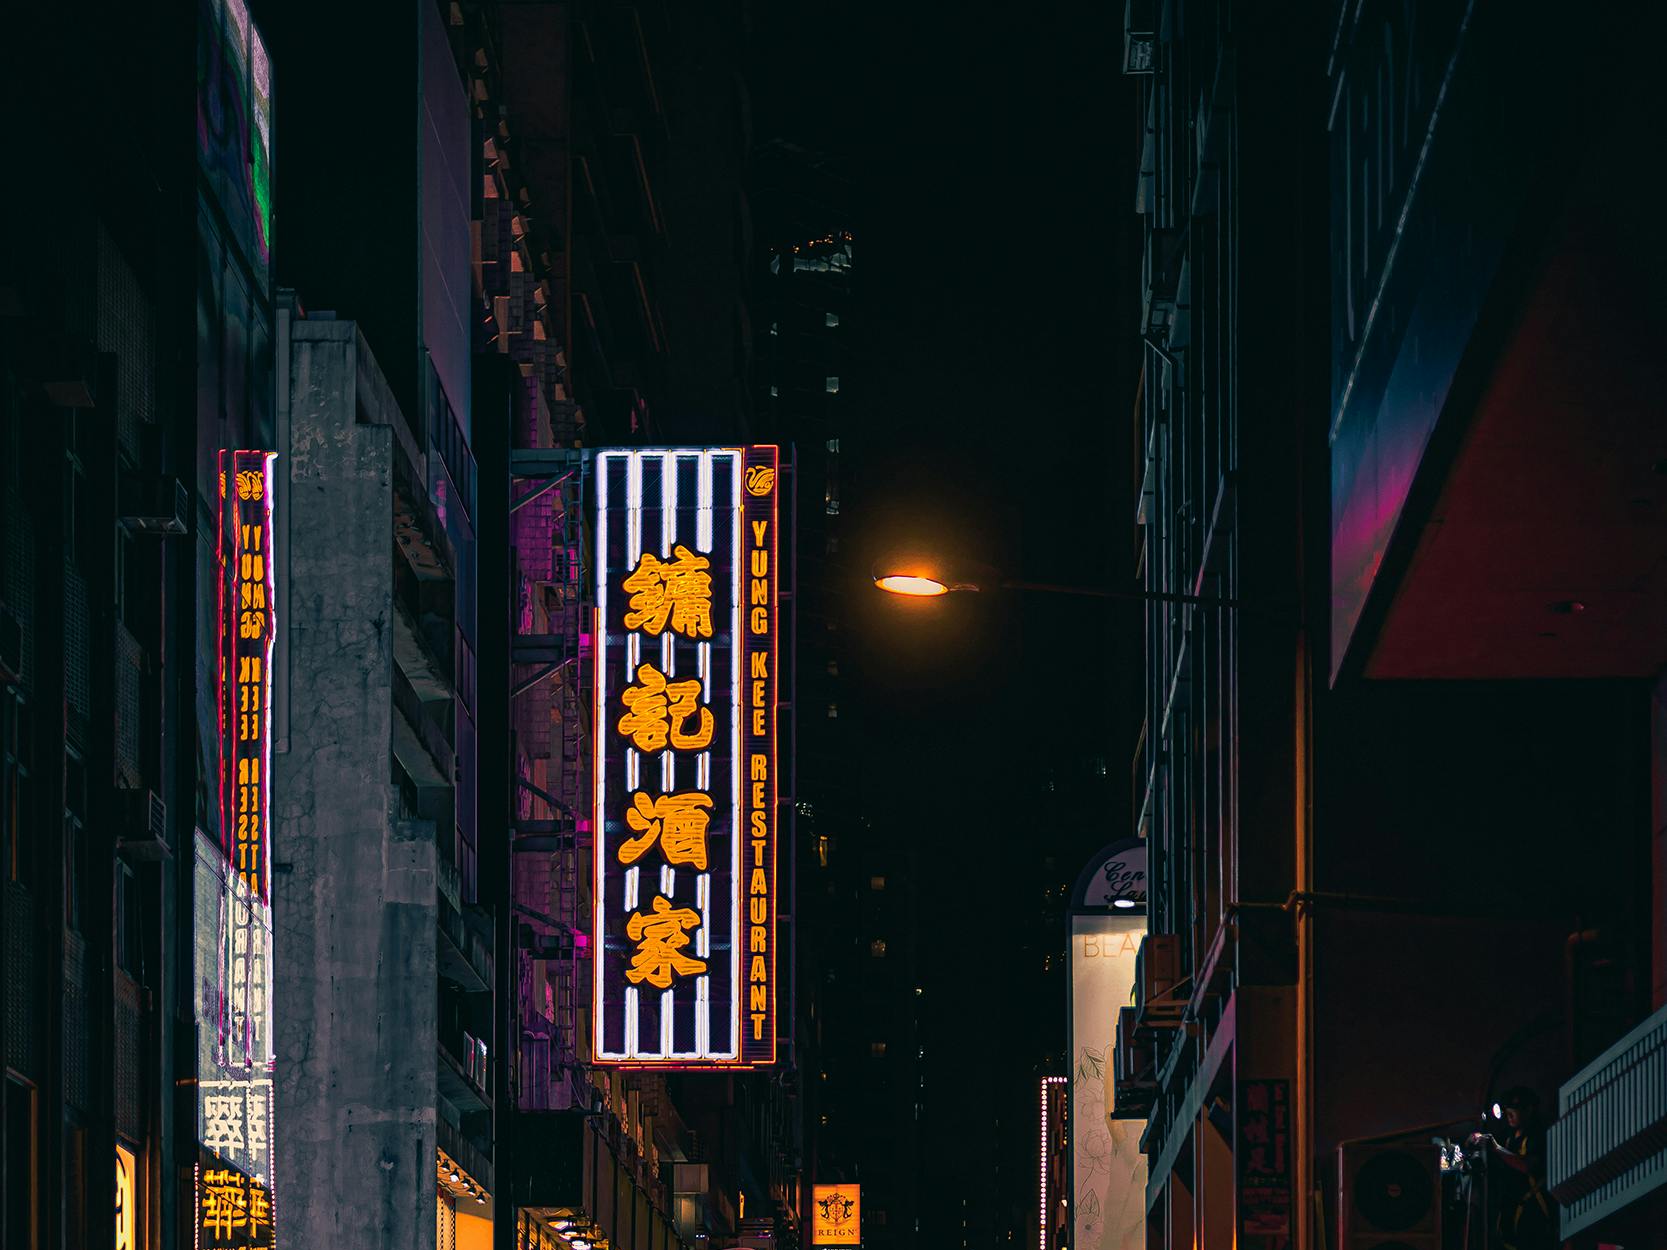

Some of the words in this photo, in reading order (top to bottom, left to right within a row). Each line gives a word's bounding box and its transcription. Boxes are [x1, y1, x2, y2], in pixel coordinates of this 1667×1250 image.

[751, 520, 768, 634] YUNG
[751, 651, 768, 736] KEE
[618, 545, 714, 989] 鏞記酒家
[750, 754, 768, 1041] RESTAURANT
[818, 1228, 855, 1236] REIGN
